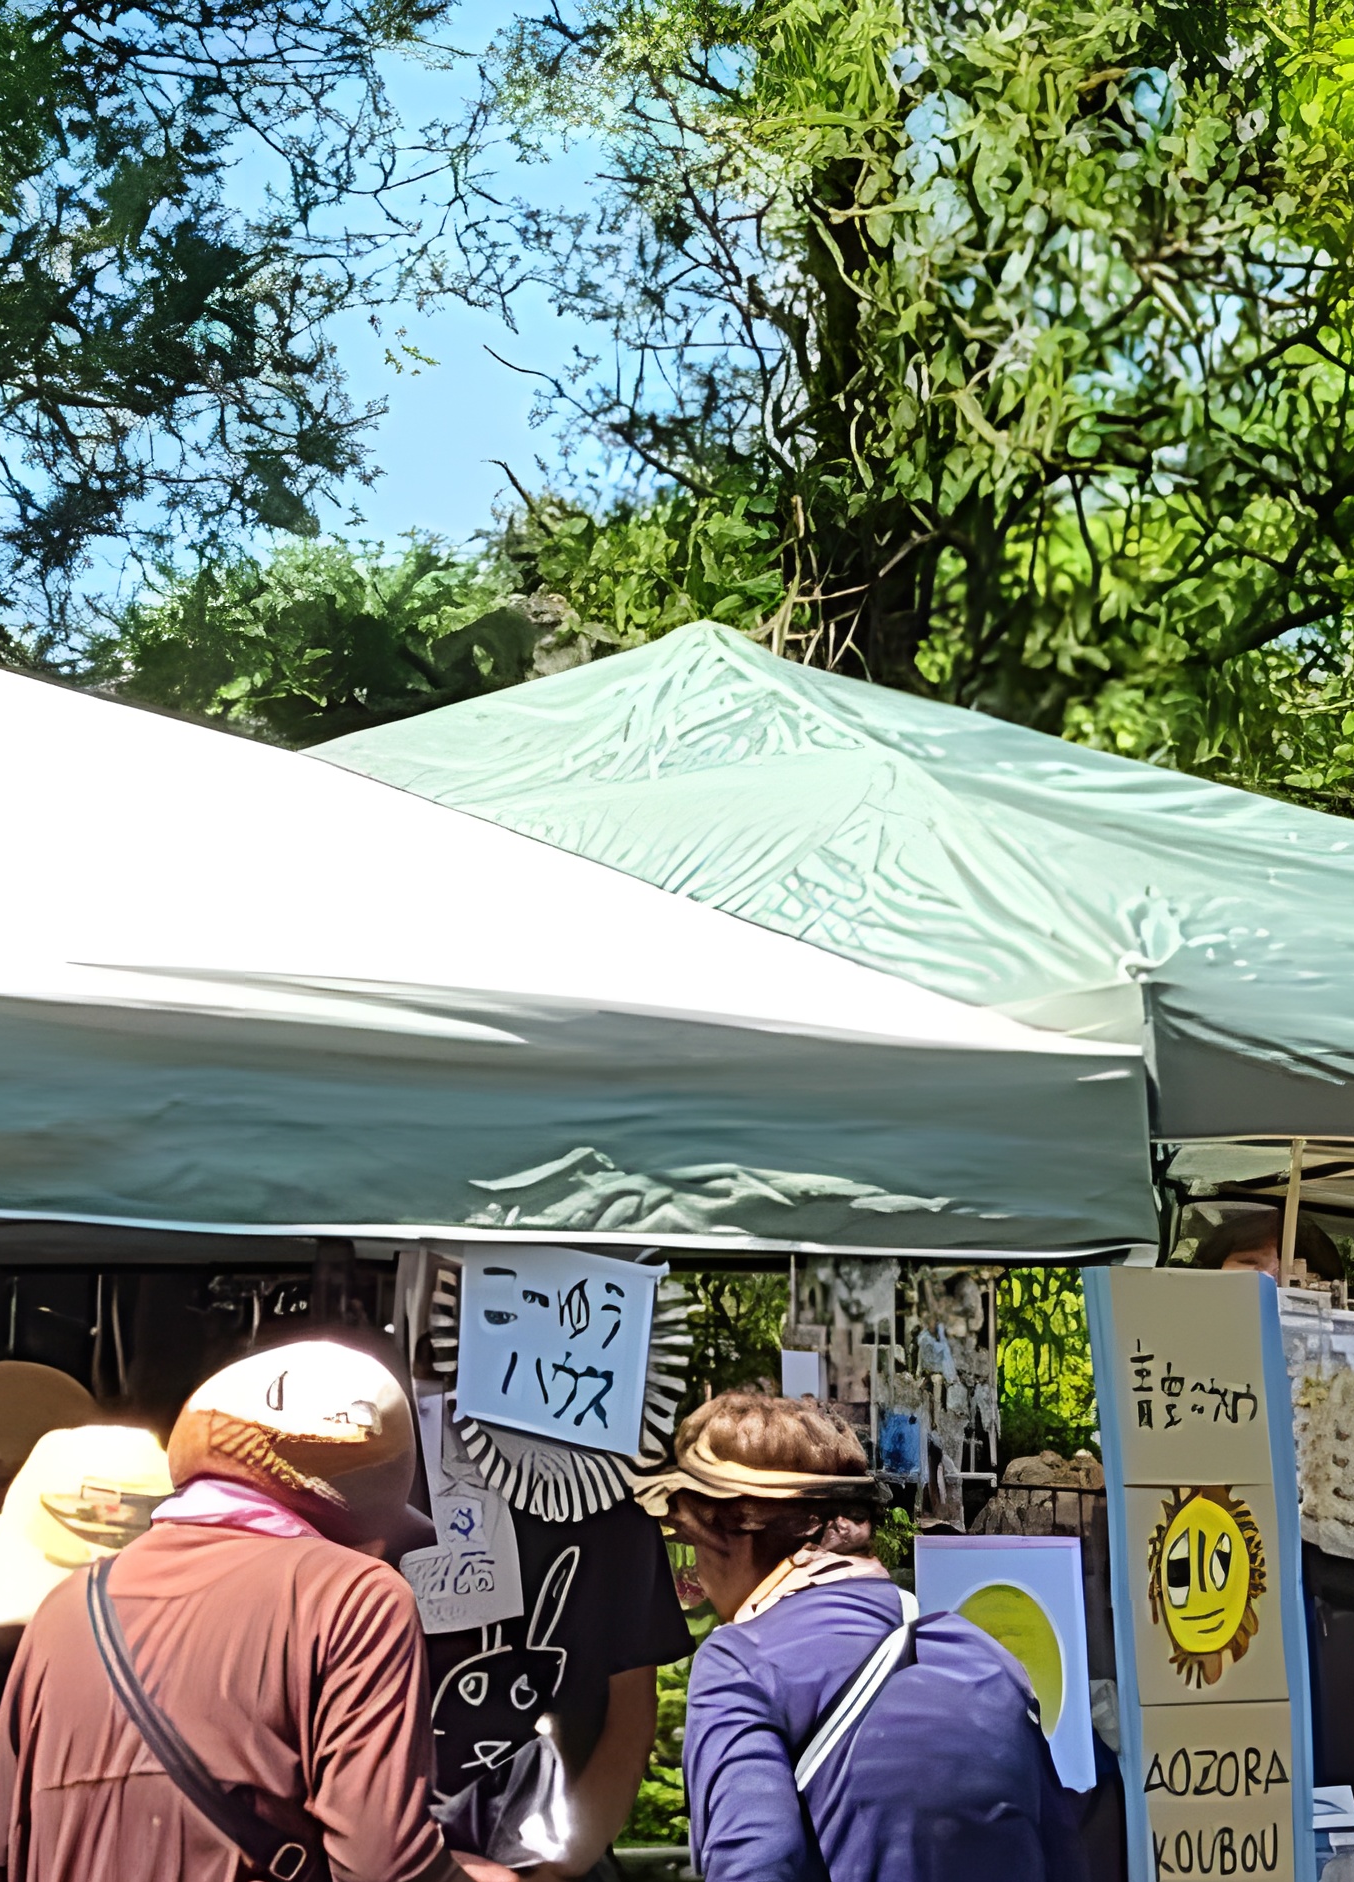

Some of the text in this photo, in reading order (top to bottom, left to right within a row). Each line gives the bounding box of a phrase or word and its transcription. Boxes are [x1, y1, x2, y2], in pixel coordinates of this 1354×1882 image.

[501, 1351, 614, 1429] ハウス
[1144, 1747, 1290, 1796] AOZORA
[1153, 1823, 1278, 1882] KOUBOU
